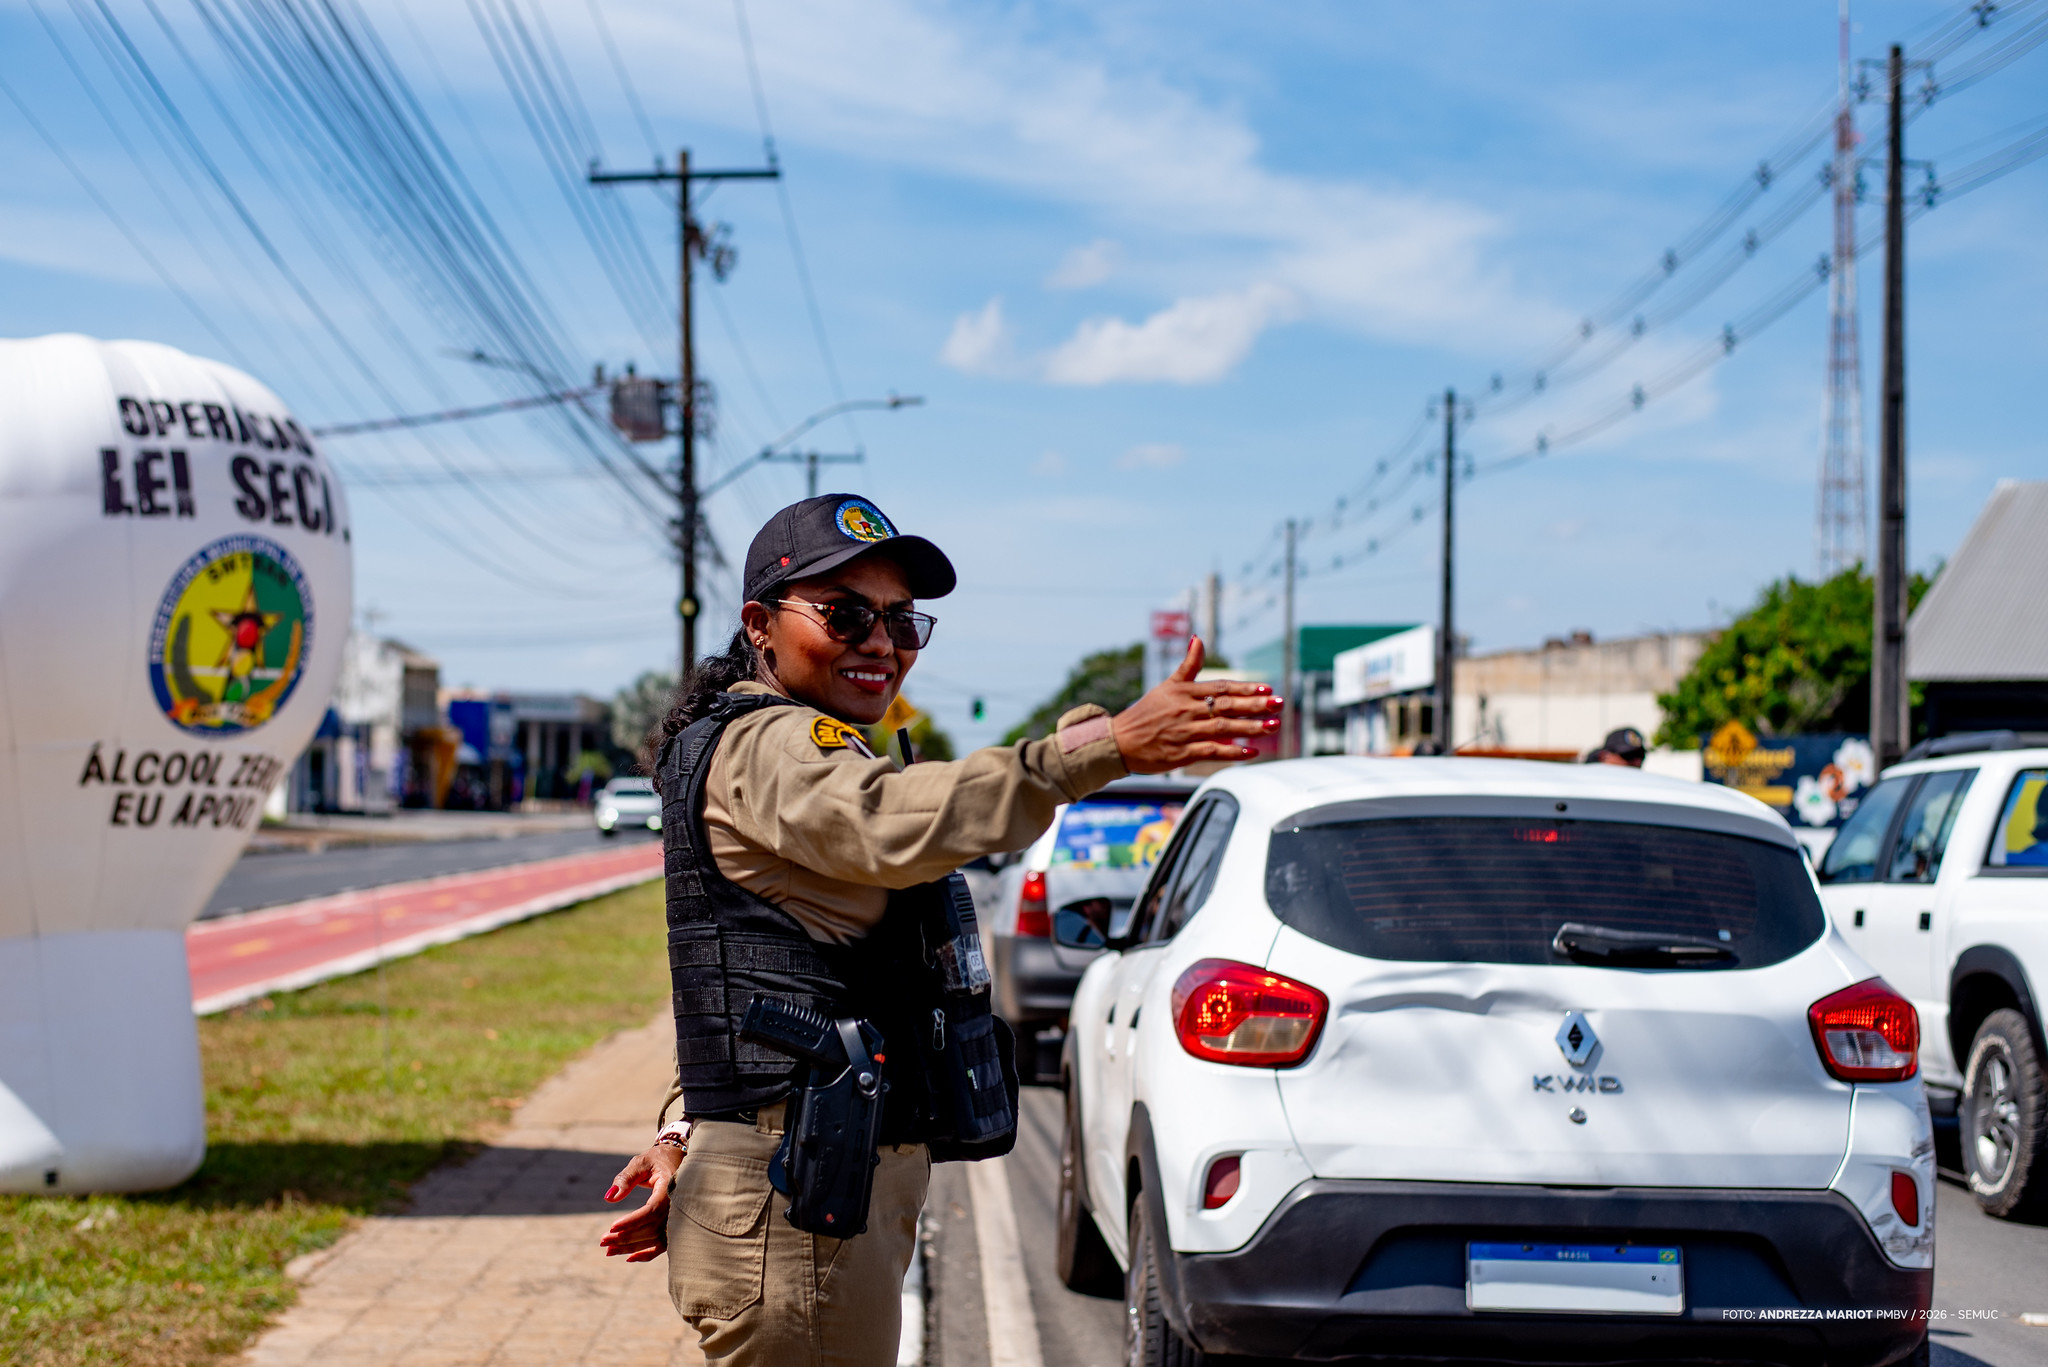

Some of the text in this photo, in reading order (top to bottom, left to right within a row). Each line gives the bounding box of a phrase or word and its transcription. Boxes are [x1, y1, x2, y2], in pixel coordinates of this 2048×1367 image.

[101, 449, 195, 517] LEI
[80, 741, 223, 788] ÁLCOOL
[111, 792, 163, 827] EU
[1533, 1075, 1623, 1094] KWID
[1556, 1251, 1591, 1262] BRASIL
